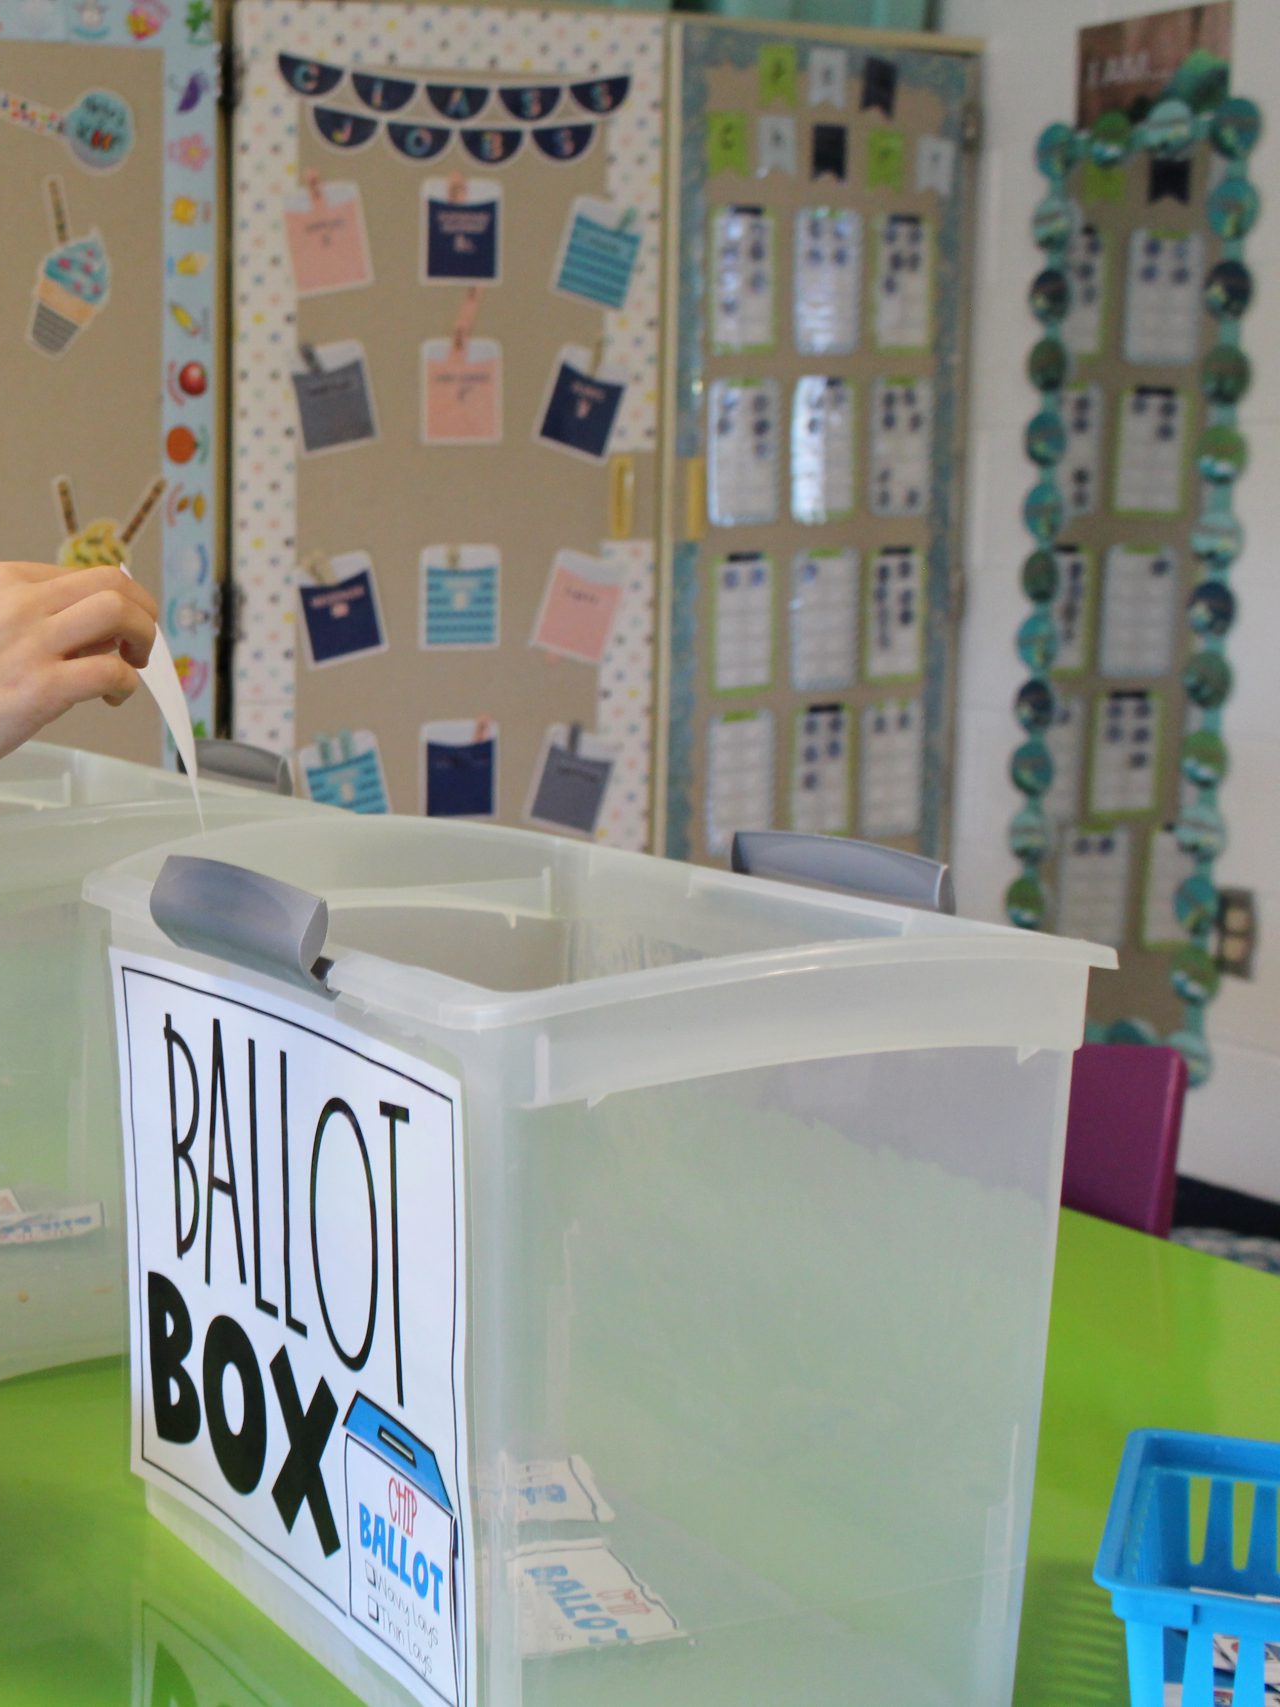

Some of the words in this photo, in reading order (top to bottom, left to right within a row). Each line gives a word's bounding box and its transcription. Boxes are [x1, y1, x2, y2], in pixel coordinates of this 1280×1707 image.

[163, 1013, 410, 1406] BALLOT
[147, 1270, 342, 1559] BOX
[388, 1476, 418, 1538] CHIP
[358, 1502, 444, 1616] BALLOT
